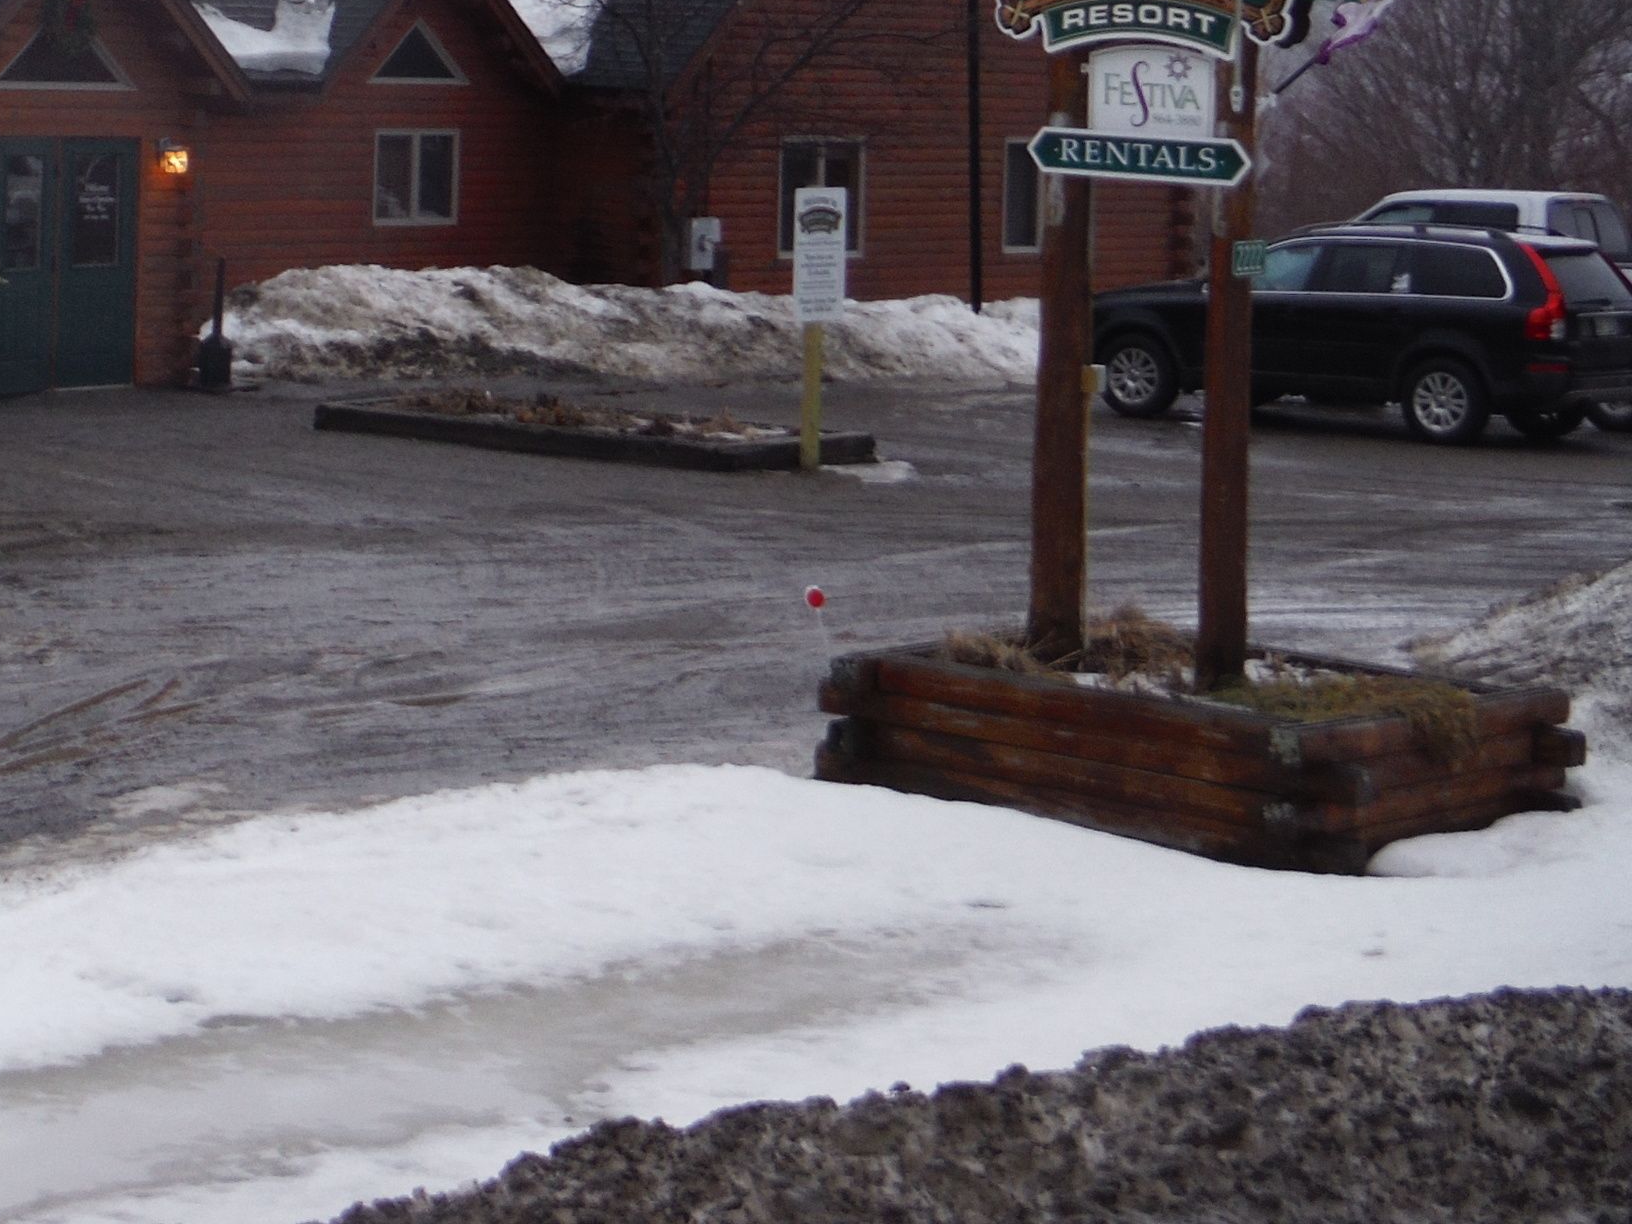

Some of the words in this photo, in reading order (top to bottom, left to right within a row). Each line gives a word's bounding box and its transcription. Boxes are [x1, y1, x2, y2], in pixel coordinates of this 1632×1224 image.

[1061, 3, 1216, 34] RESORT
[1104, 61, 1200, 127] FESTIVA
[1059, 138, 1217, 171] RENTALS
